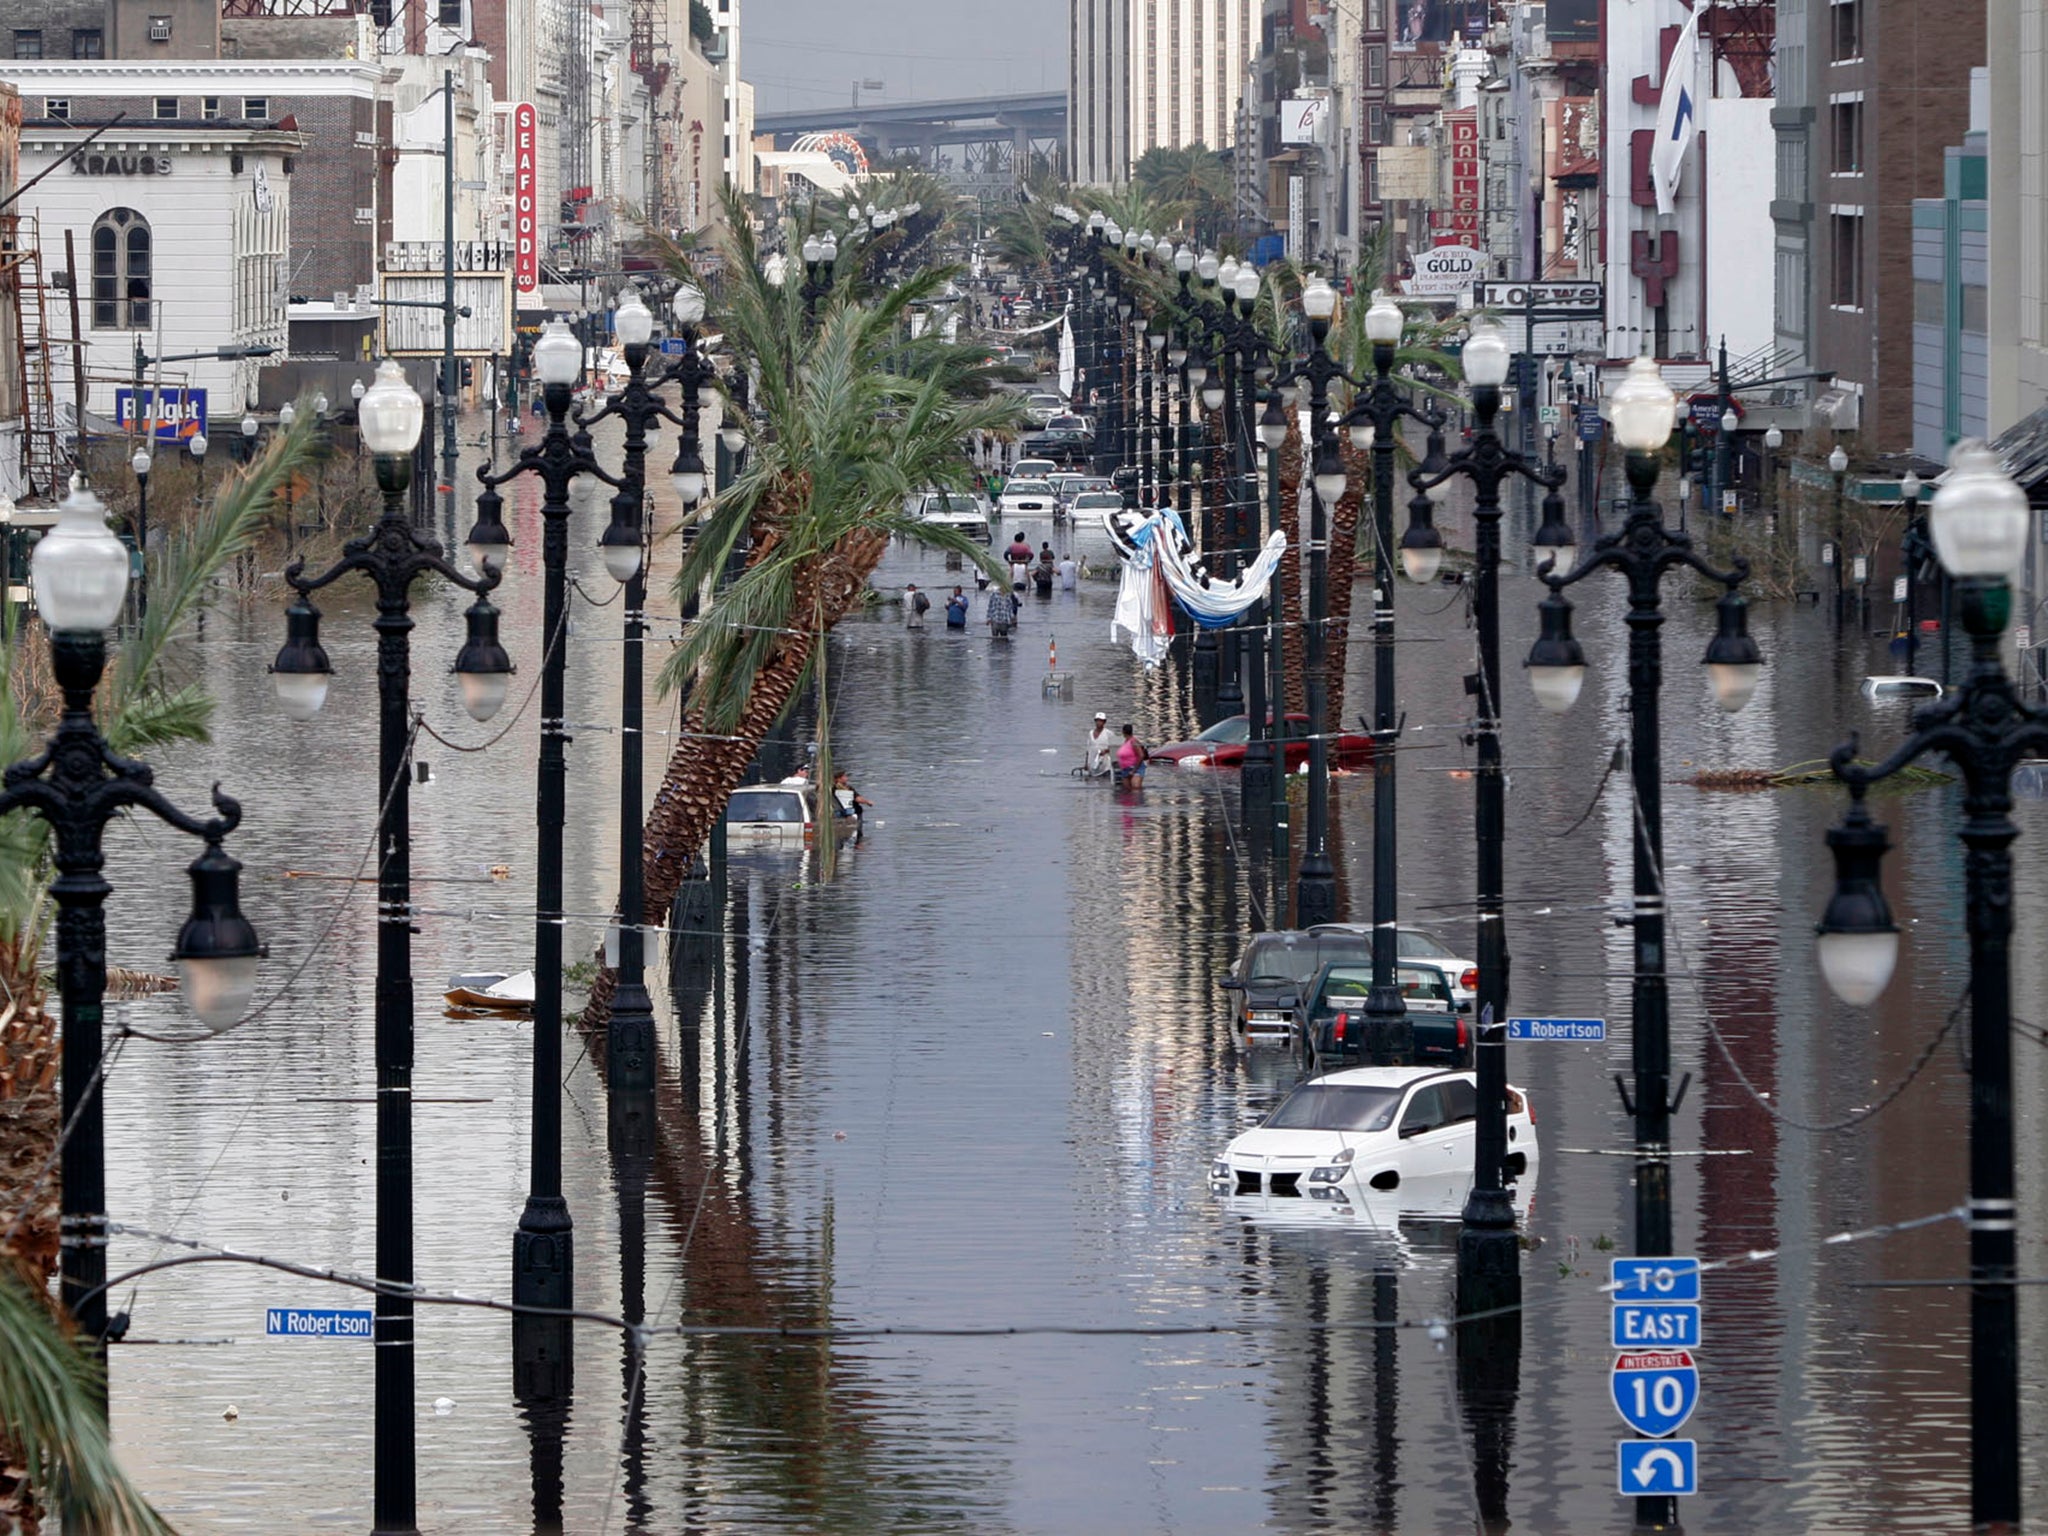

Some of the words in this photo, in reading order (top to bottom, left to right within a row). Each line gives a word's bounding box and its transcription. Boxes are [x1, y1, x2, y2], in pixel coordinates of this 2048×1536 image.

[71, 153, 171, 175] KRAUSS
[520, 111, 531, 254] SEAFOOD
[1458, 126, 1473, 247] DAILEYS
[1427, 259, 1472, 273] GOLD
[518, 275, 533, 285] CO.
[1487, 288, 1596, 305] LOEWS
[1511, 1021, 1521, 1037] S
[1531, 1021, 1601, 1037] Robertson
[1633, 1267, 1675, 1292] TO
[269, 1311, 281, 1332] N
[287, 1311, 369, 1334] Robertson
[1624, 1310, 1689, 1339] EAST
[1623, 1355, 1684, 1369] INTERSTATE
[1632, 1376, 1683, 1418] 10
